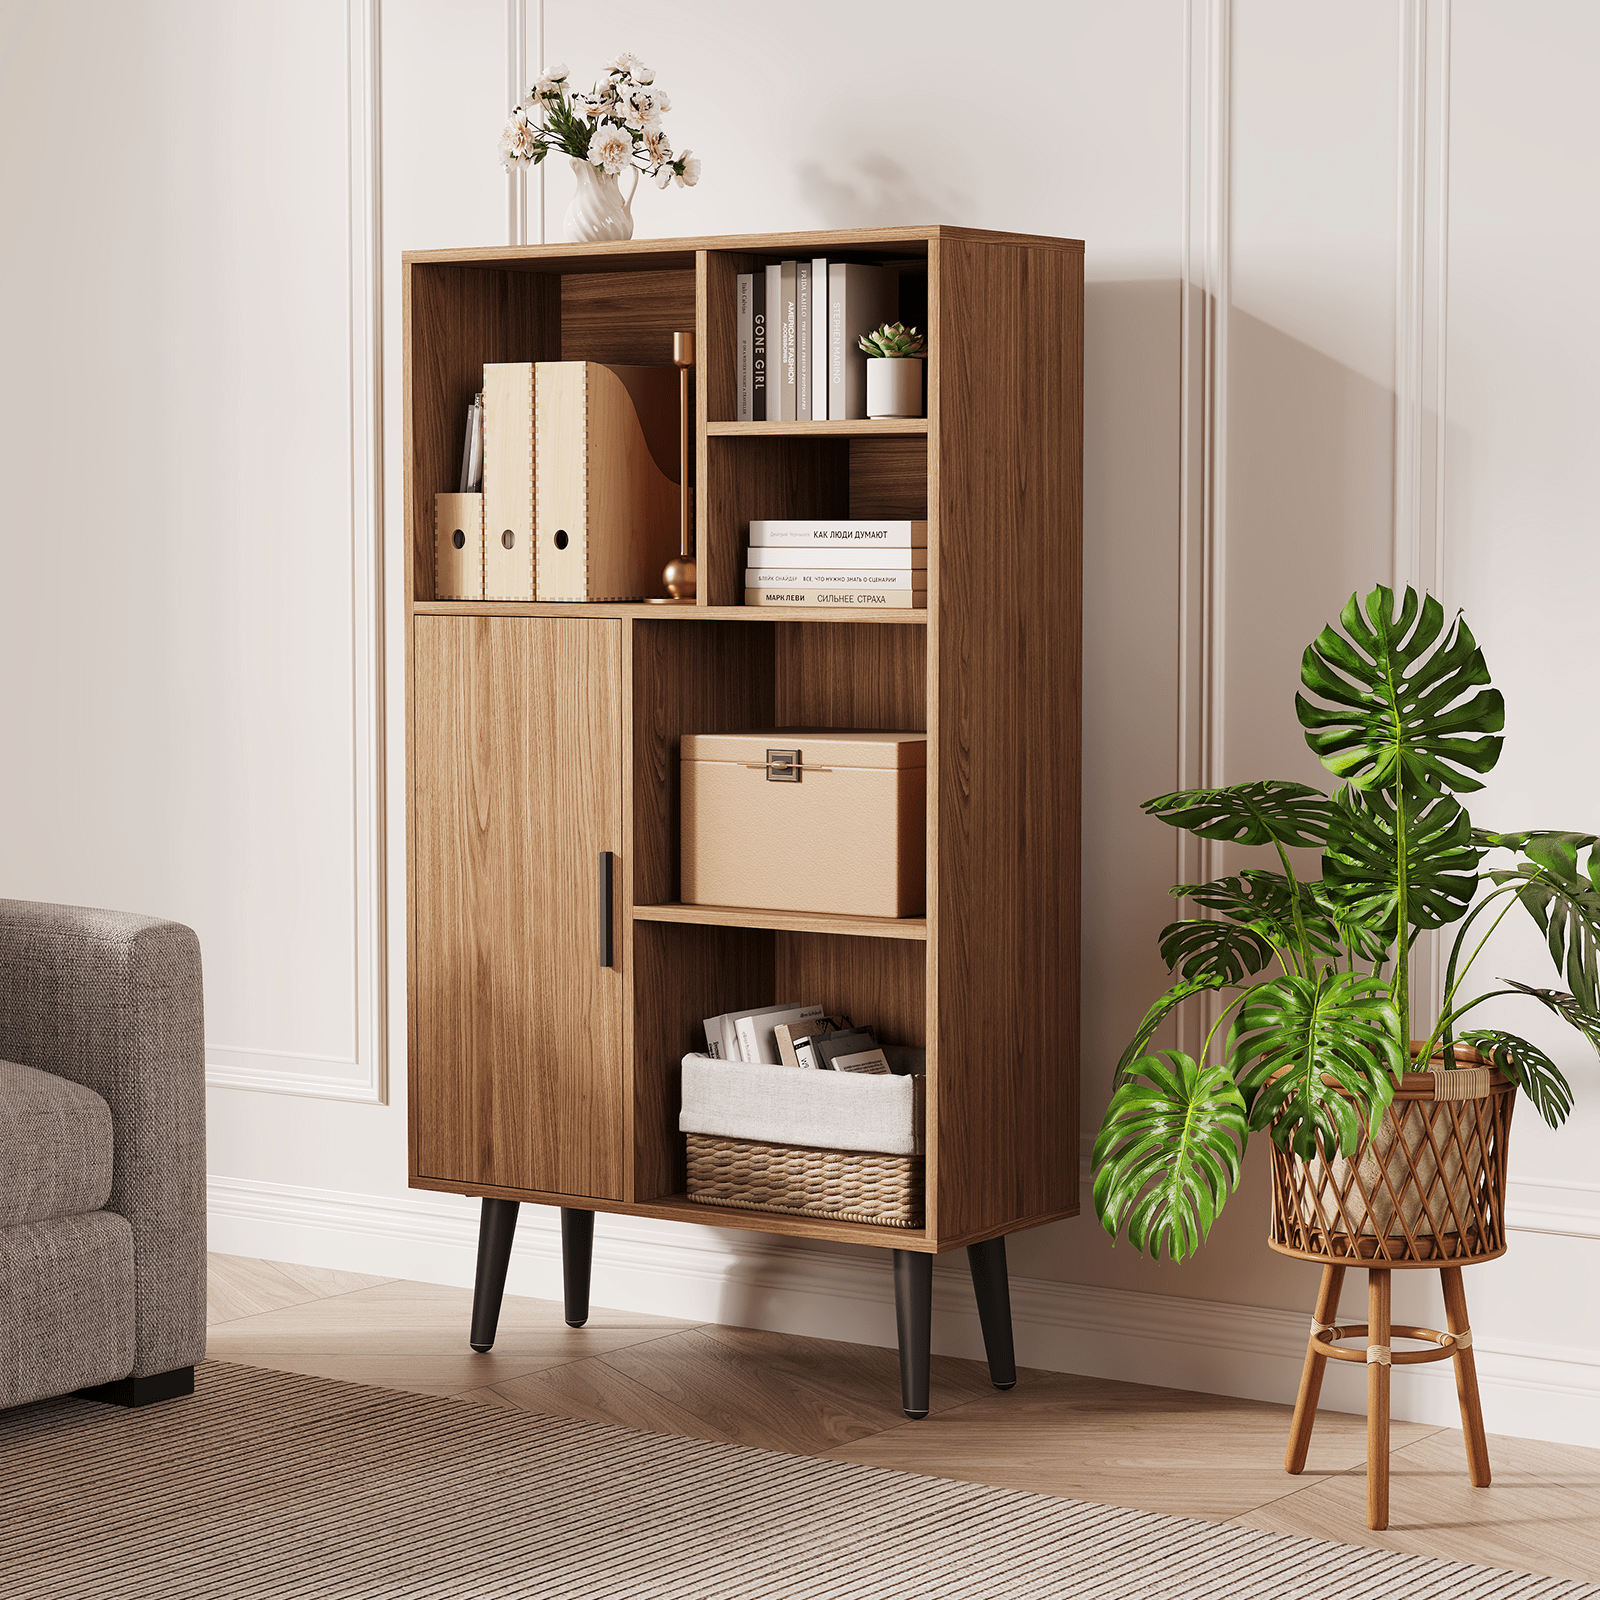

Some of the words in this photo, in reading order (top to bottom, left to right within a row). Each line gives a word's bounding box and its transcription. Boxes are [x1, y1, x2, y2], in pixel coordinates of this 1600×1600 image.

[755, 314, 765, 354] GONE
[833, 302, 841, 345] STEPHEN
[755, 359, 765, 390] GIRL
[833, 346, 841, 384] MARINO
[813, 530, 828, 539] КАК
[829, 530, 854, 540] ЛЮДИ
[854, 530, 888, 540] ДУМАЮТ
[785, 594, 805, 602] ЛЕВИ
[817, 594, 854, 603] СИЛЬНЕЕ
[857, 594, 886, 604] СТРАХА
